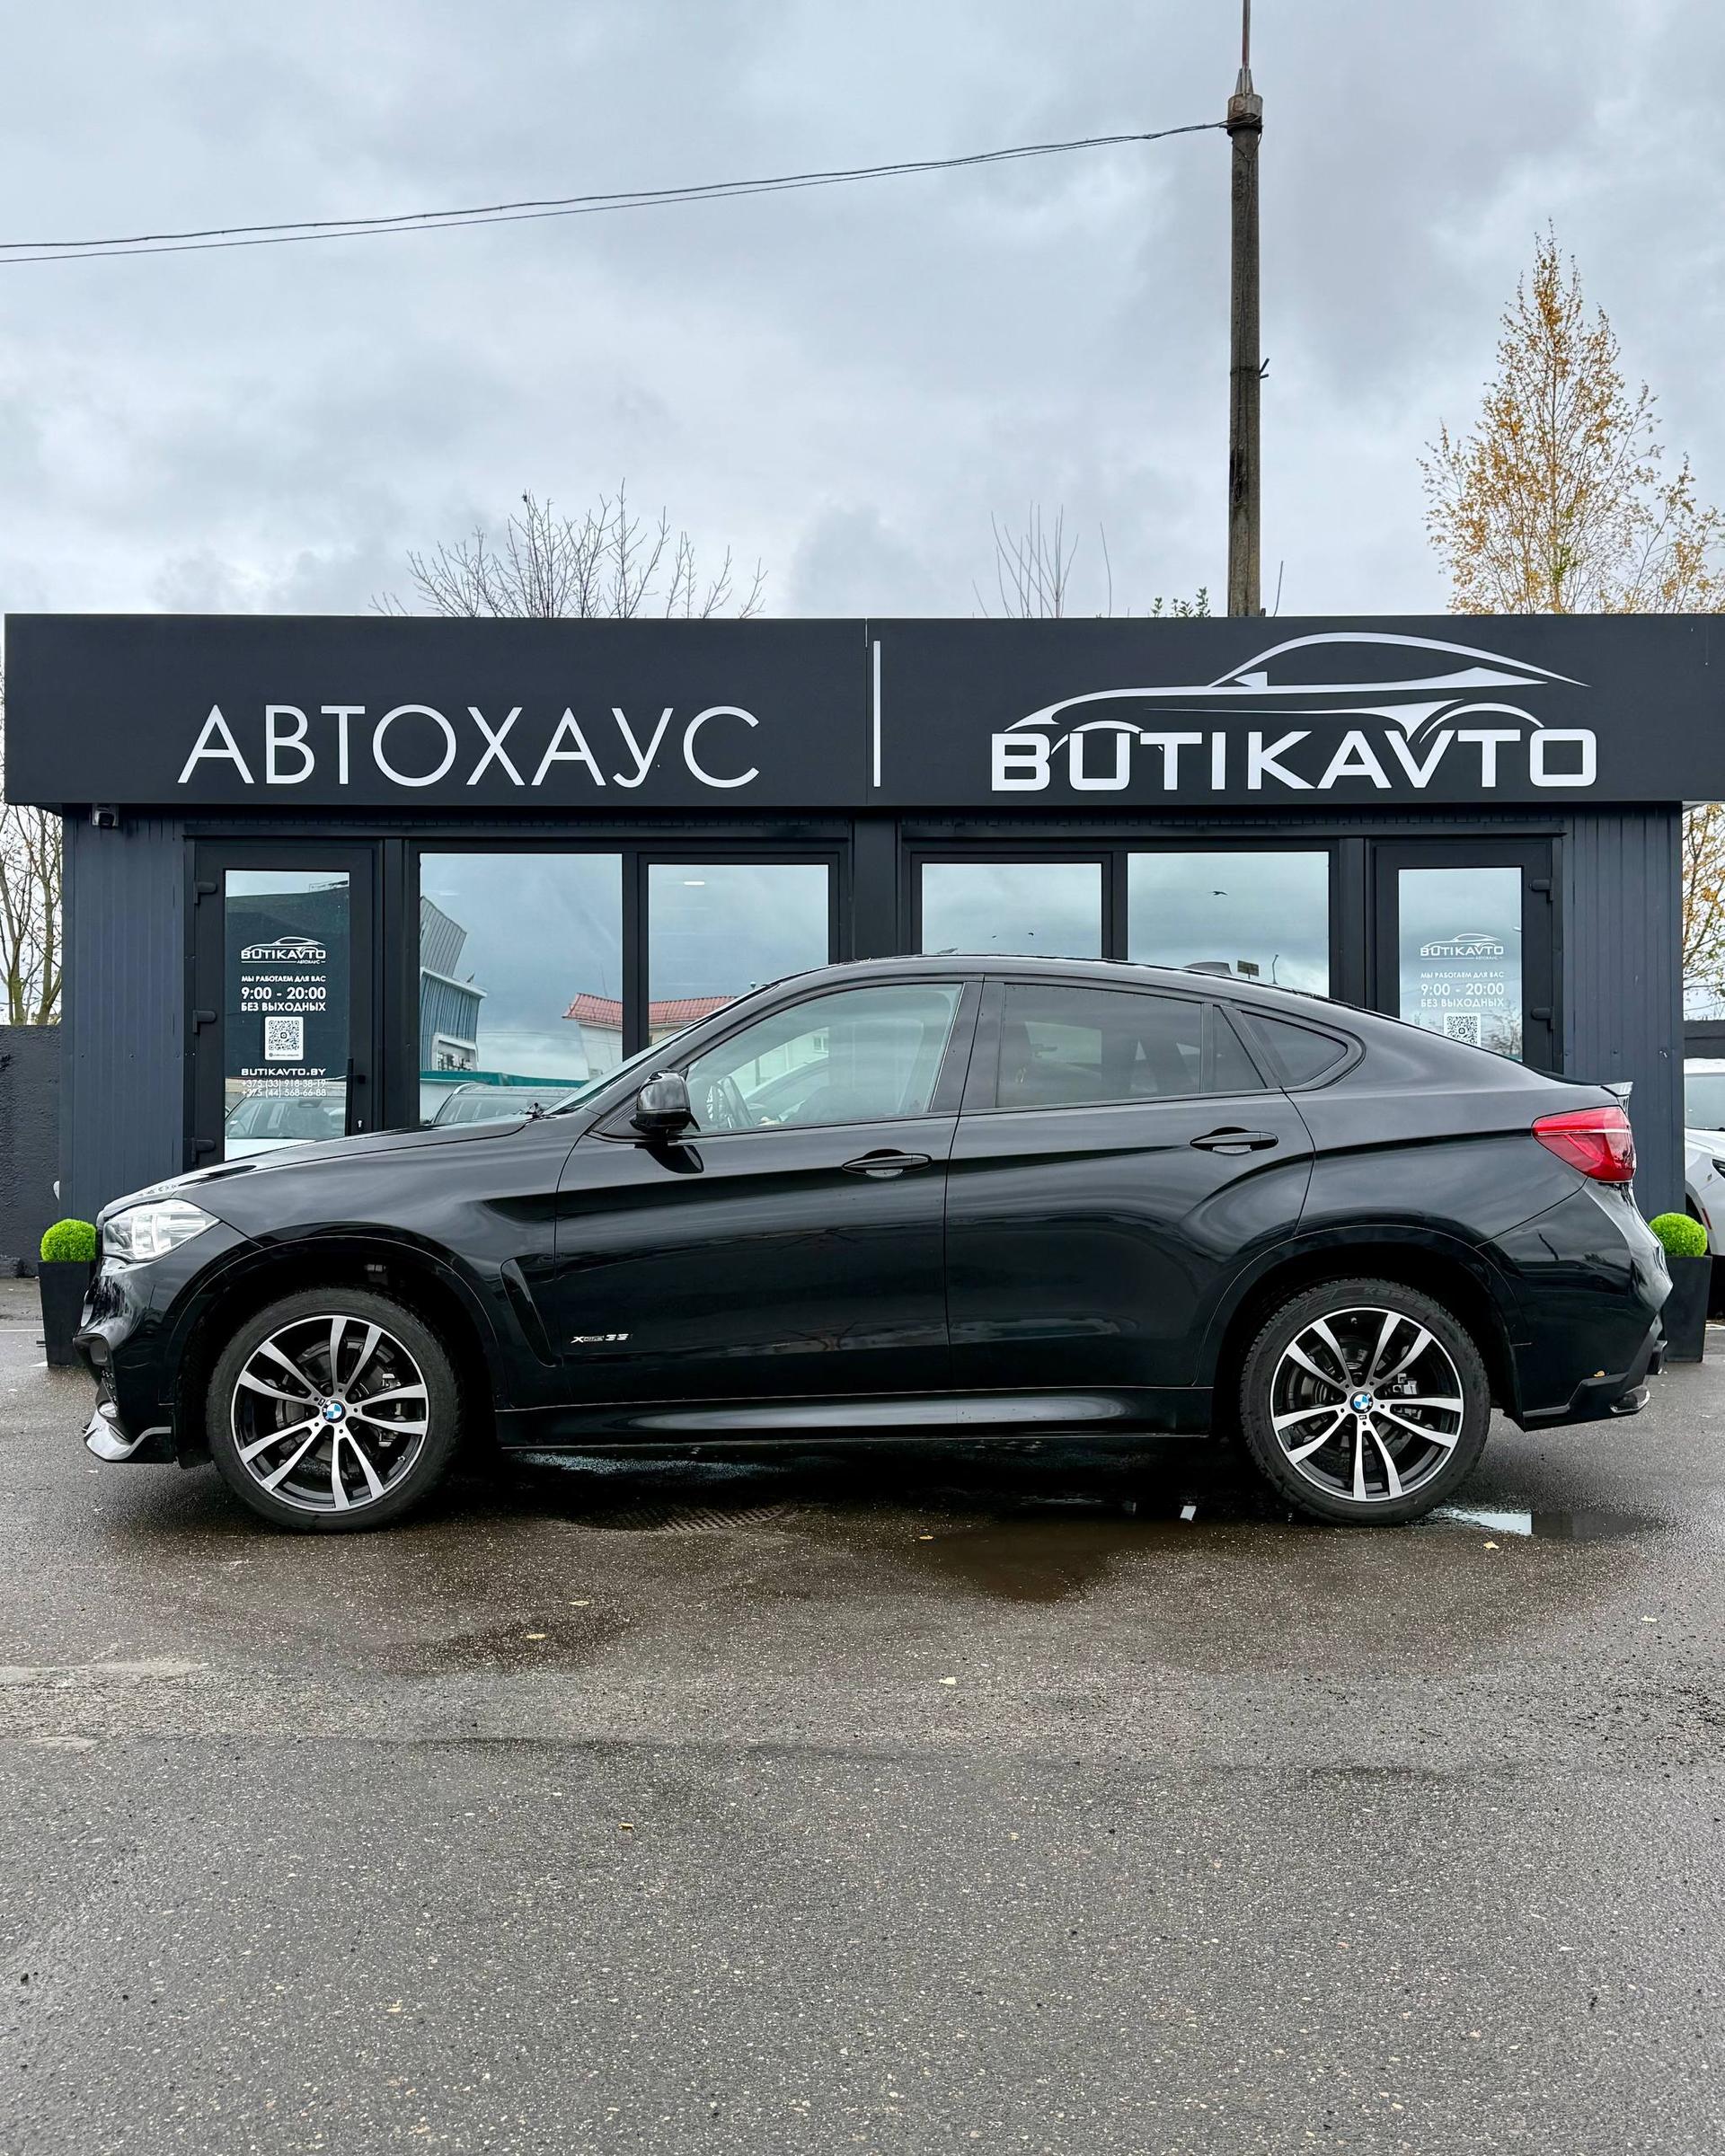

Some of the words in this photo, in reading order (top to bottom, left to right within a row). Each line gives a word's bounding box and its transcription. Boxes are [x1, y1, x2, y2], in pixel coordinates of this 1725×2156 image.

[177, 704, 759, 789] АВТОХАУС
[991, 729, 1597, 791] BUTIKAVTO
[241, 949, 326, 959] BUTIKAVTO
[1420, 946, 1504, 956] BUTIKAVTO
[241, 986, 272, 1000] 9:00
[287, 986, 326, 1000] 20:00
[1420, 983, 1450, 995] 9:00
[1465, 983, 1504, 995] 20:00
[241, 1002, 259, 1012] БЕЗ
[261, 1002, 326, 1012] ВЫХОДНЫХ
[1420, 999, 1438, 1008] БЕЗ
[1441, 998, 1504, 1008] ВЫХОДНЫХ
[241, 1068, 326, 1076] BUTIKAVTO.BY
